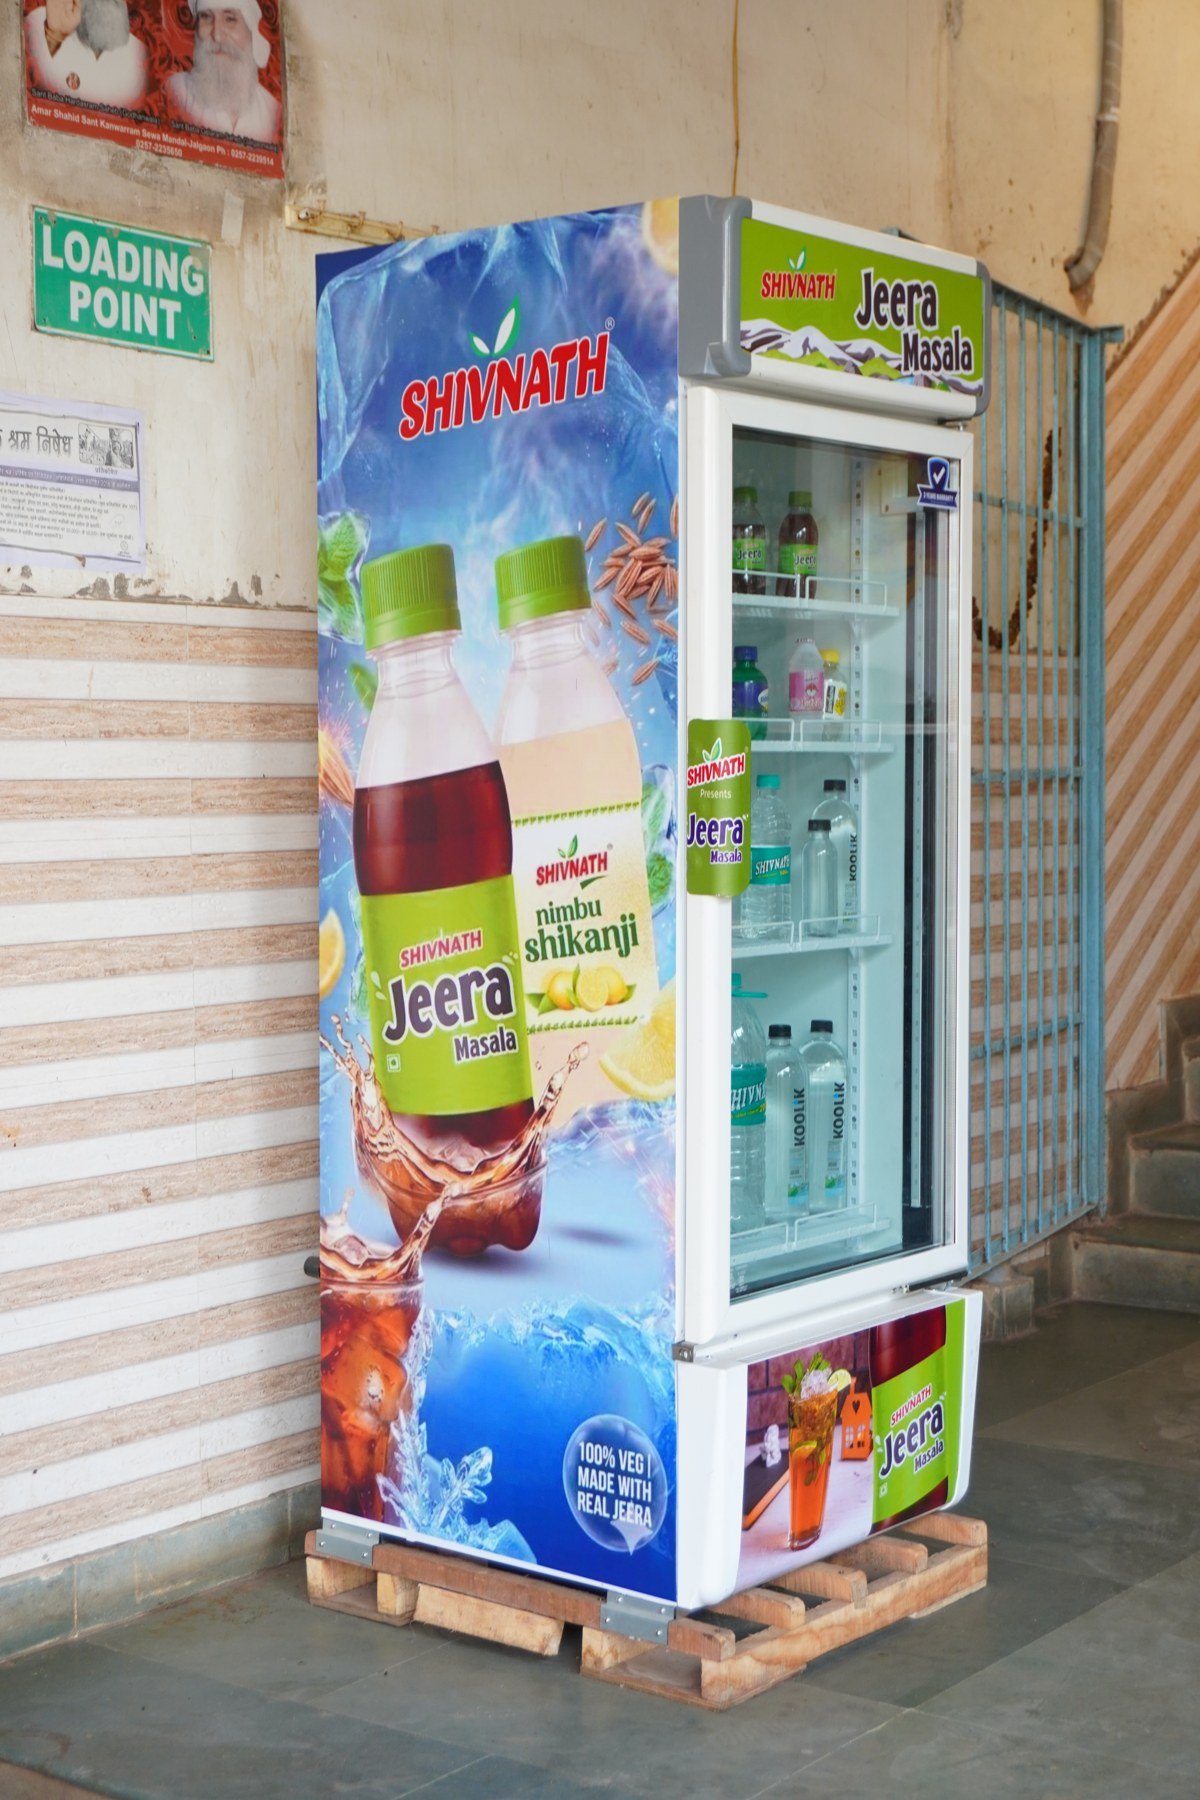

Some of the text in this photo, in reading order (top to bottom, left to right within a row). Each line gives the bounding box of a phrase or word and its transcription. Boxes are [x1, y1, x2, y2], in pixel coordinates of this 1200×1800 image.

[31, 104, 51, 117] Amar
[53, 108, 79, 123] Shahid
[81, 115, 98, 127] Sant
[100, 119, 140, 136] Kanwarram
[142, 128, 160, 140] Sewa
[42, 224, 204, 296] LOADING
[762, 272, 836, 300] SHIVNATH
[855, 268, 938, 329] Jeera
[69, 280, 181, 339] POINT
[902, 327, 973, 374] Masala
[400, 332, 609, 441] SHIVNATH
[8, 430, 32, 450] श्रम
[36, 426, 73, 456] निषेध
[687, 754, 745, 786] SHIVNATH
[700, 788, 732, 800] Presents
[687, 815, 743, 847] Jeera
[536, 851, 608, 887] SHIVNATH
[710, 849, 742, 864] Masala
[536, 897, 602, 926] nimbu
[400, 929, 482, 968] SHIVNATH
[525, 913, 639, 962] shikanji
[384, 966, 514, 1042] Jeera
[454, 1026, 517, 1062] Masala
[891, 1385, 932, 1427] SHIVNATH
[881, 1402, 944, 1476] Jeera
[914, 1440, 945, 1473] Masala
[579, 1441, 644, 1475] 100% VEG
[578, 1465, 652, 1502] MADE WITH
[577, 1490, 652, 1528] REAL JEERA
